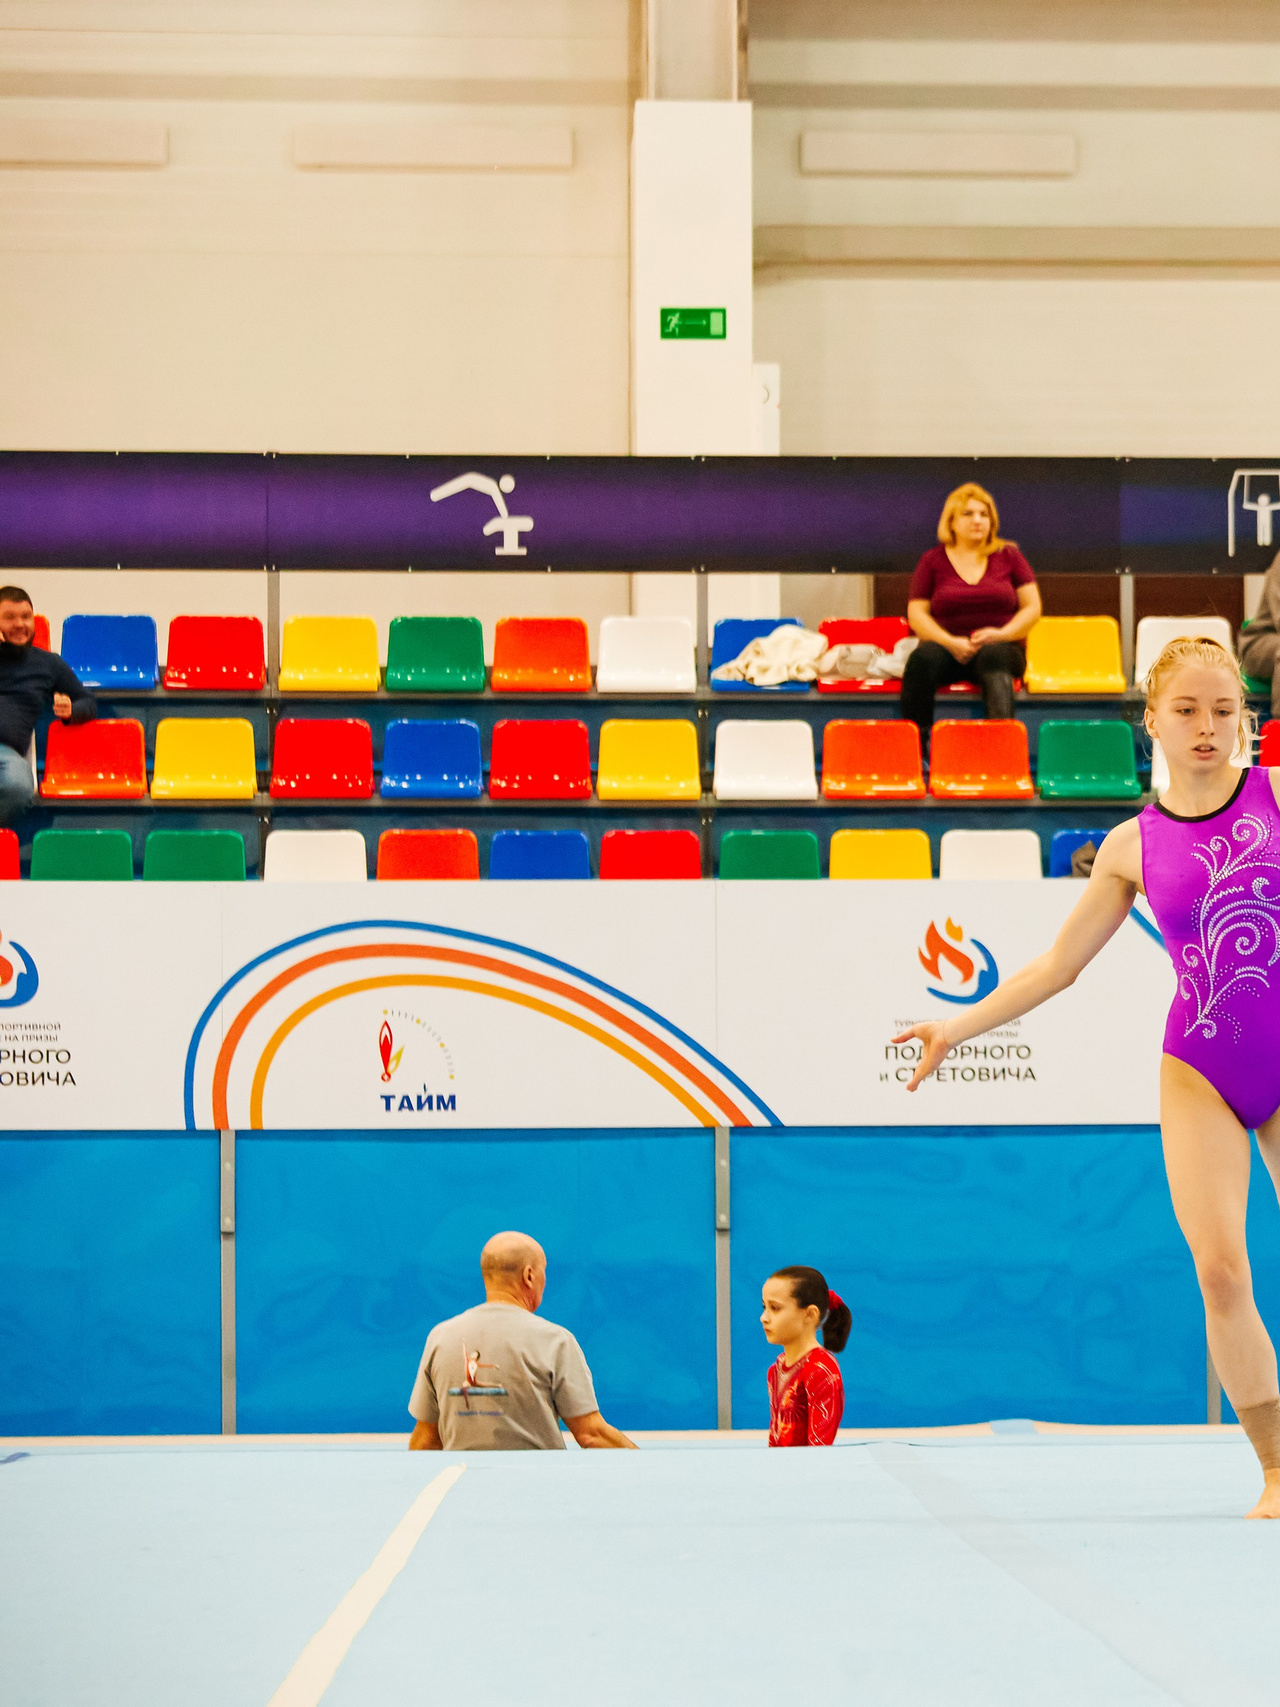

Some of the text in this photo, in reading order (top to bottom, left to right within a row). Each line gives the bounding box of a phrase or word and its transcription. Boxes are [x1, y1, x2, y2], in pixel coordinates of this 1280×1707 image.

[0, 1049, 71, 1064] РНОГО
[0, 1071, 77, 1086] ОВИЧА
[380, 1084, 456, 1112] ТАЙМ
